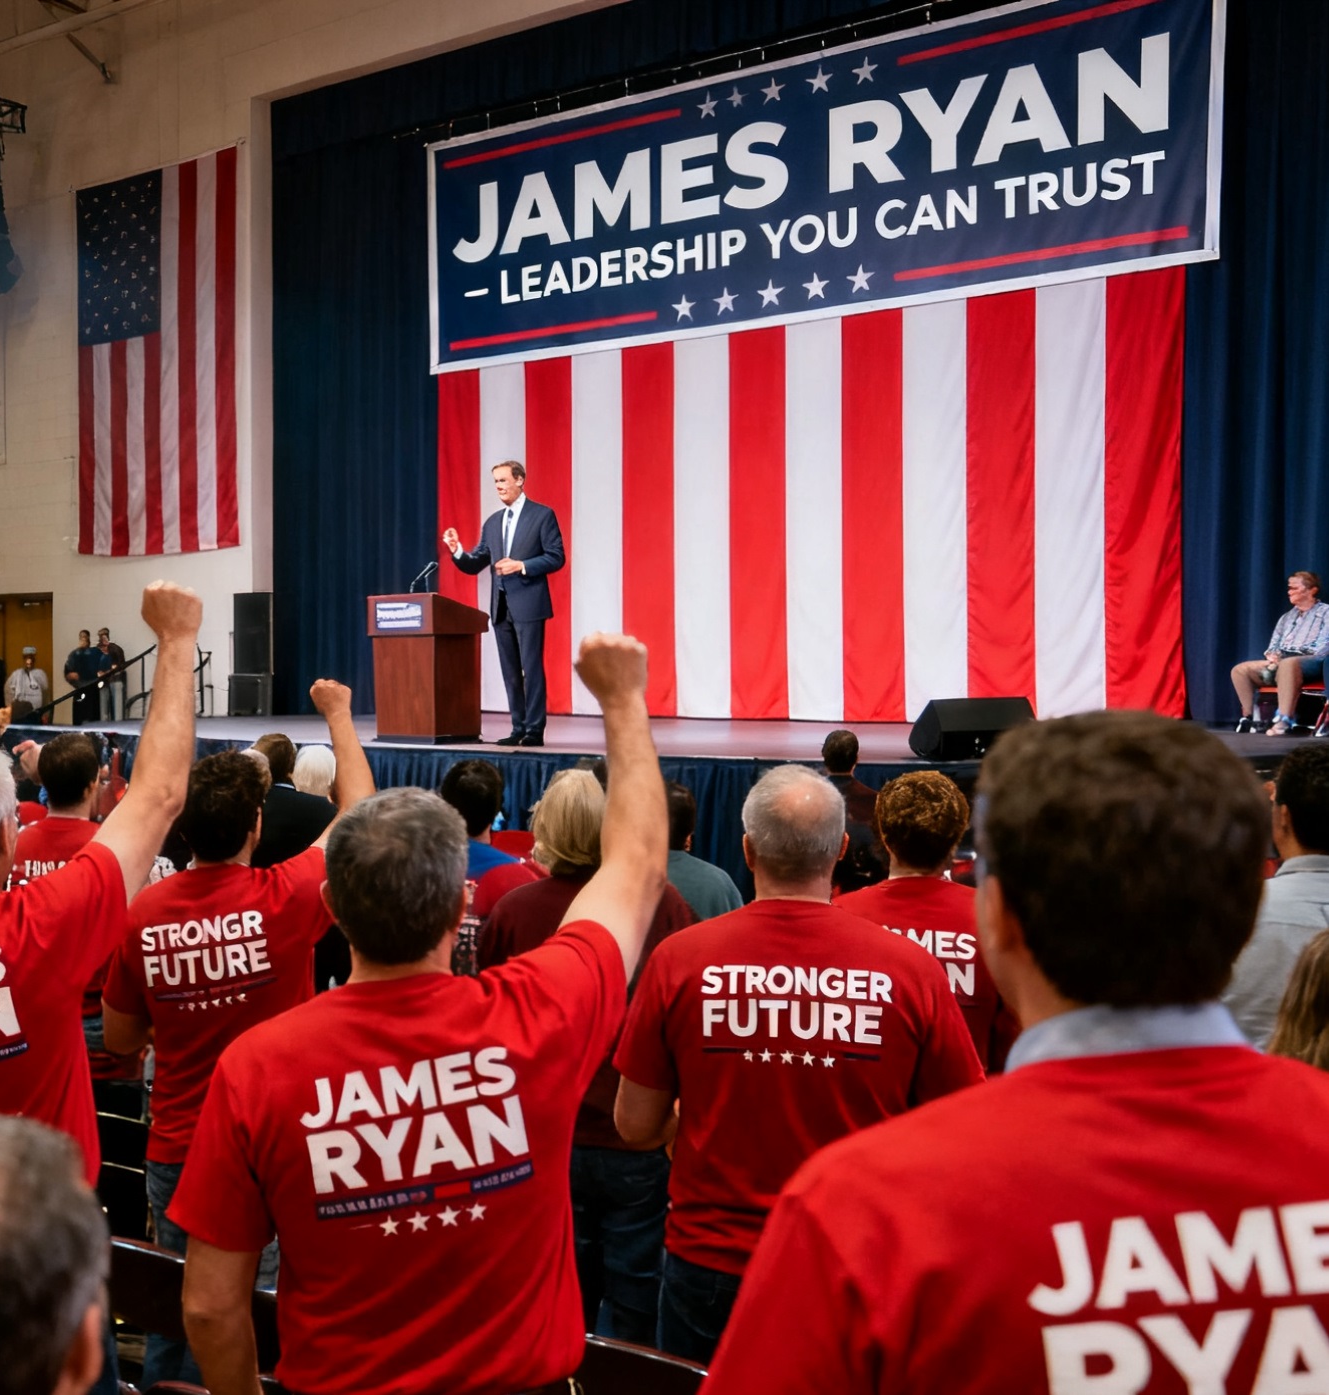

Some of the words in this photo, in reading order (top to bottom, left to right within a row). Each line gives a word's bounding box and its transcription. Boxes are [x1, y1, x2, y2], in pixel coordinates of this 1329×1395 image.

[453, 121, 789, 263] JAMES
[828, 31, 1170, 194] RYAN
[501, 229, 747, 304] LEADERSHIP
[760, 206, 858, 259] YOU
[874, 185, 978, 240] CAN
[994, 150, 1166, 219] TRUST
[143, 938, 272, 988] FUTURE
[881, 924, 977, 960] MES
[701, 965, 893, 1004] STRONGER
[702, 998, 883, 1045] FUTURE
[299, 1046, 517, 1129] JAMES
[306, 1094, 530, 1195] RYAN
